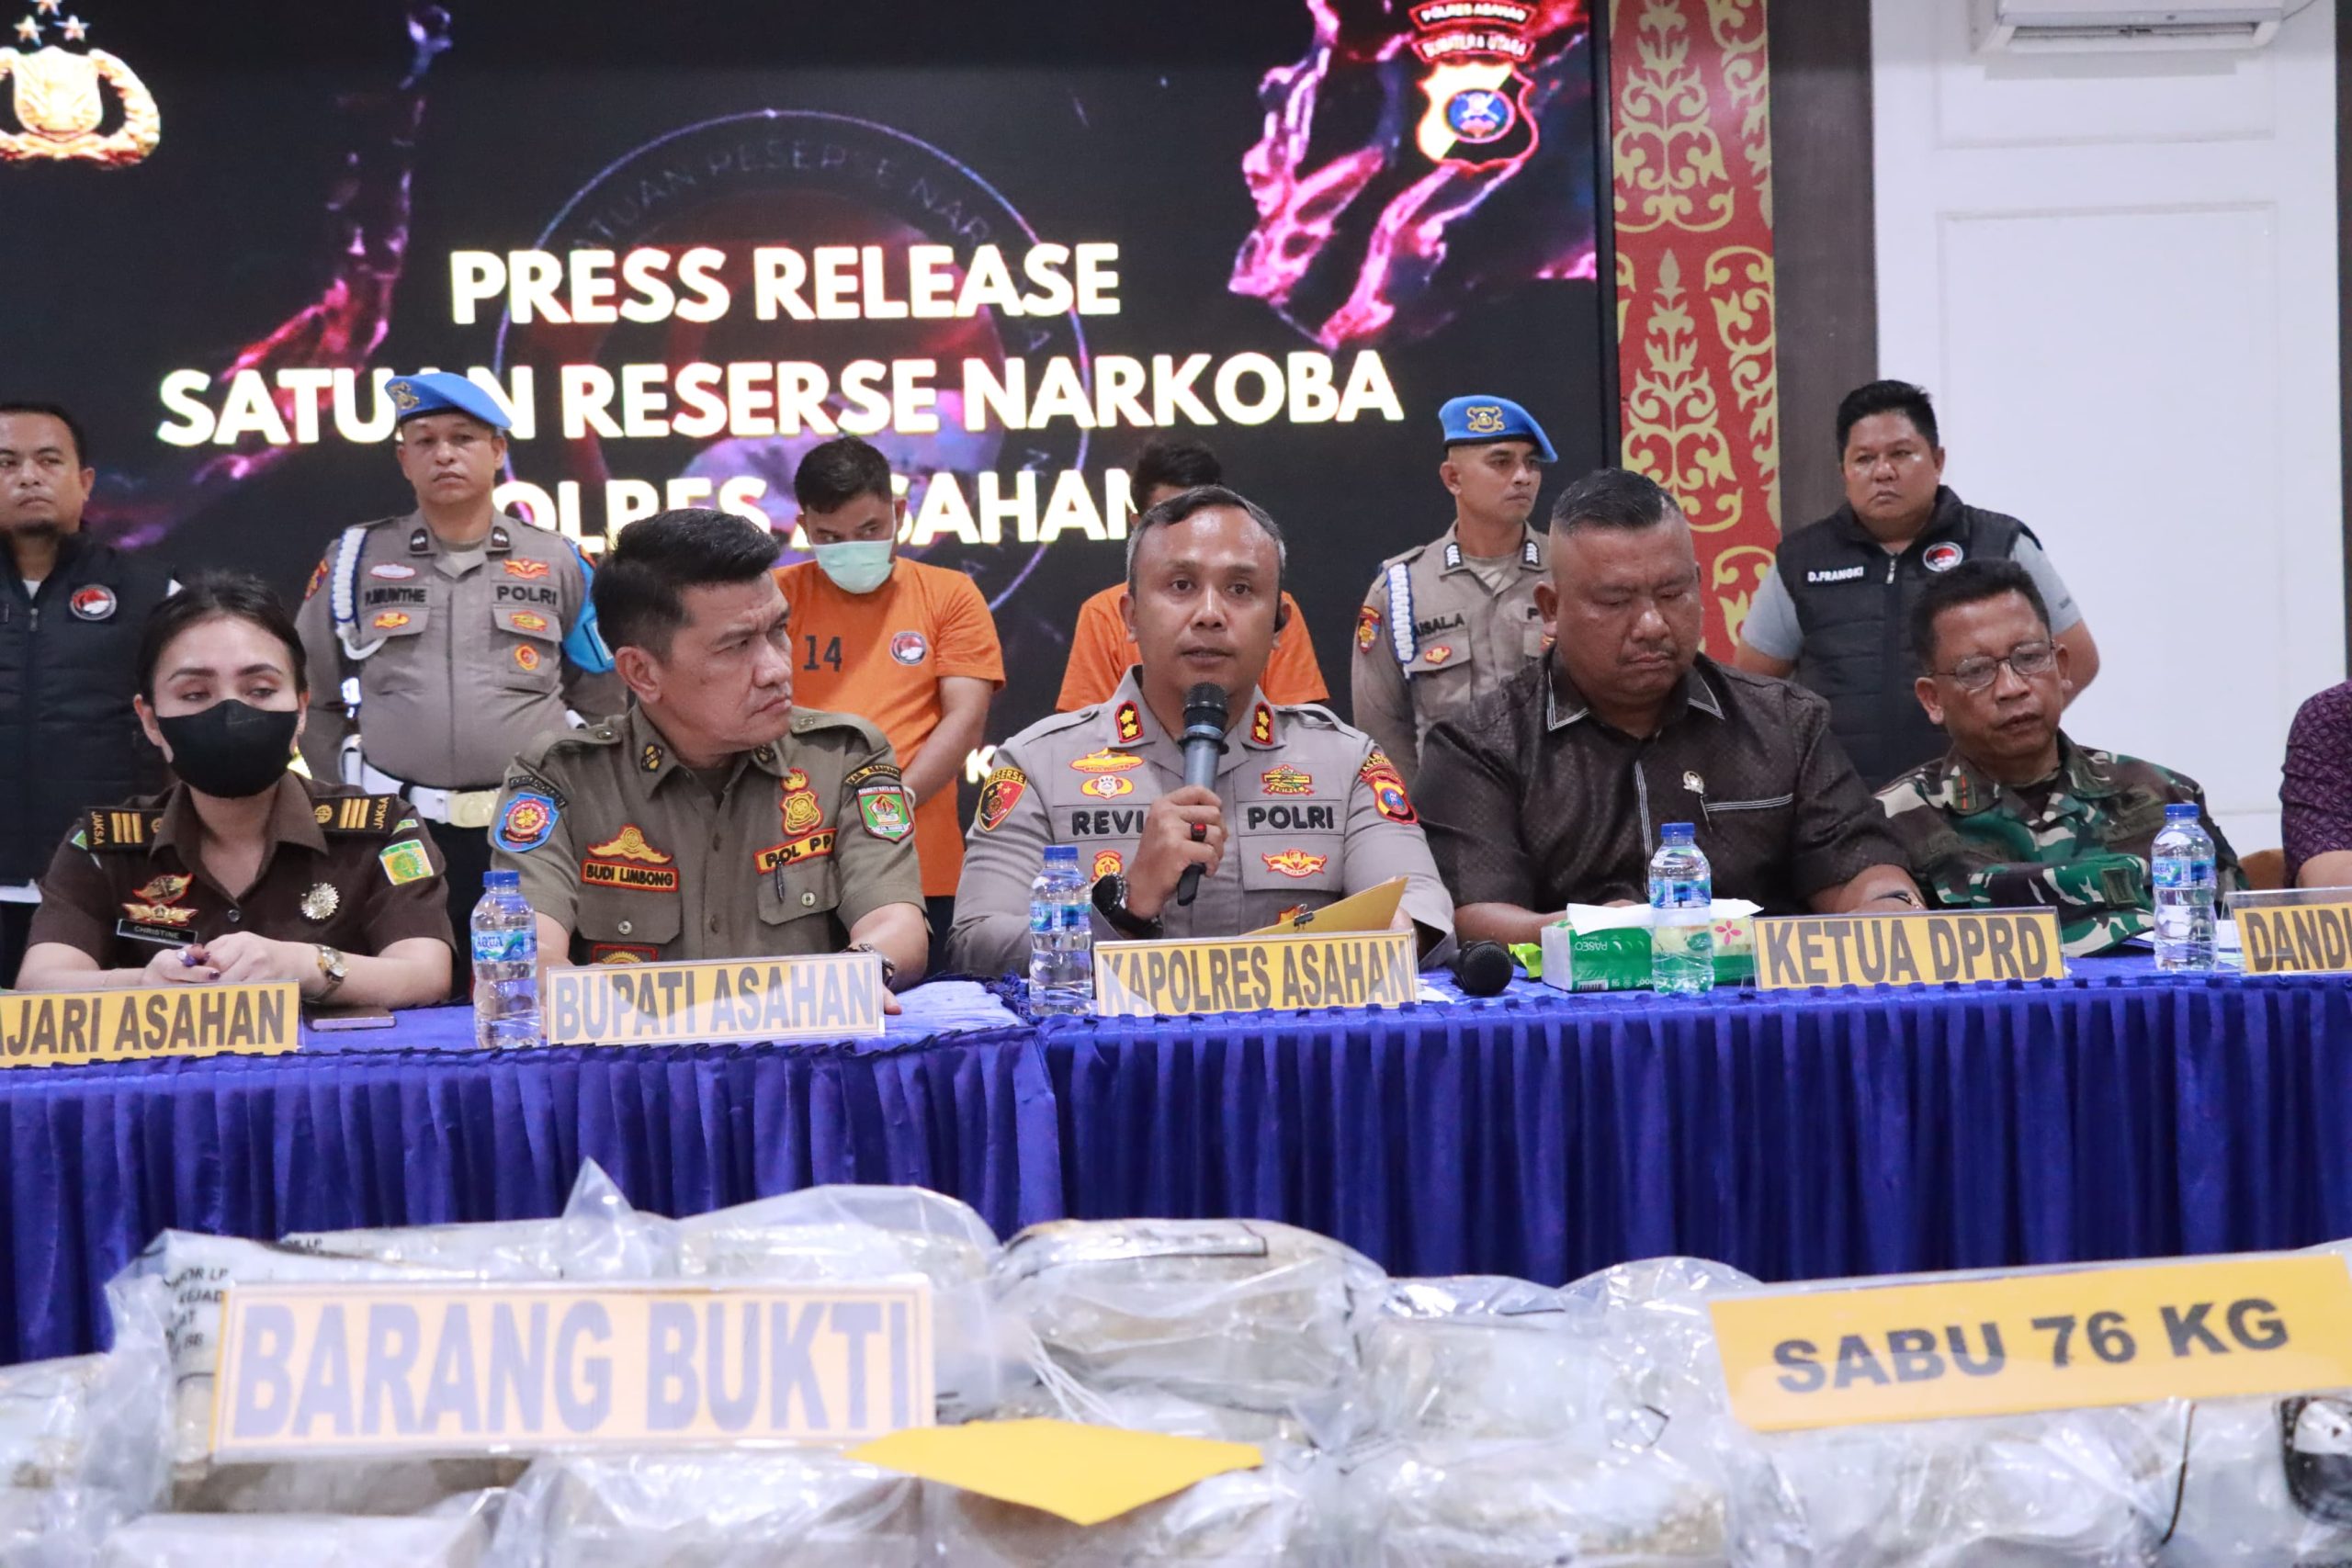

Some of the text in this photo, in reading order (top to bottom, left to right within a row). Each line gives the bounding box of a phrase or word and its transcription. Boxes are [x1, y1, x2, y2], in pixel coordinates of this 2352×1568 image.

[449, 243, 1122, 325] PRESS RELEASE
[157, 349, 1405, 446] SATUN RESERSE NARKOBA
[496, 585, 558, 605] POLRI
[803, 635, 842, 672] 14
[91, 811, 105, 846] JAKSA
[373, 796, 390, 829] JAKSA
[1247, 805, 1335, 831] POLRI
[585, 863, 673, 886] BUDI LIMBONG
[764, 844, 801, 868] POL
[133, 924, 181, 940] CHRISTINE
[1575, 941, 1608, 952] PASEO
[1764, 916, 2049, 986] KETUA DPRD
[1102, 940, 1415, 1016] KAPOLRES ASAHAN
[555, 961, 876, 1042] BUPATI ASAHAN
[0, 988, 286, 1057] JARI ASAHAN
[1771, 1296, 2290, 1394] SABU 76 KG
[232, 1299, 910, 1438] BARANG BUKTI
